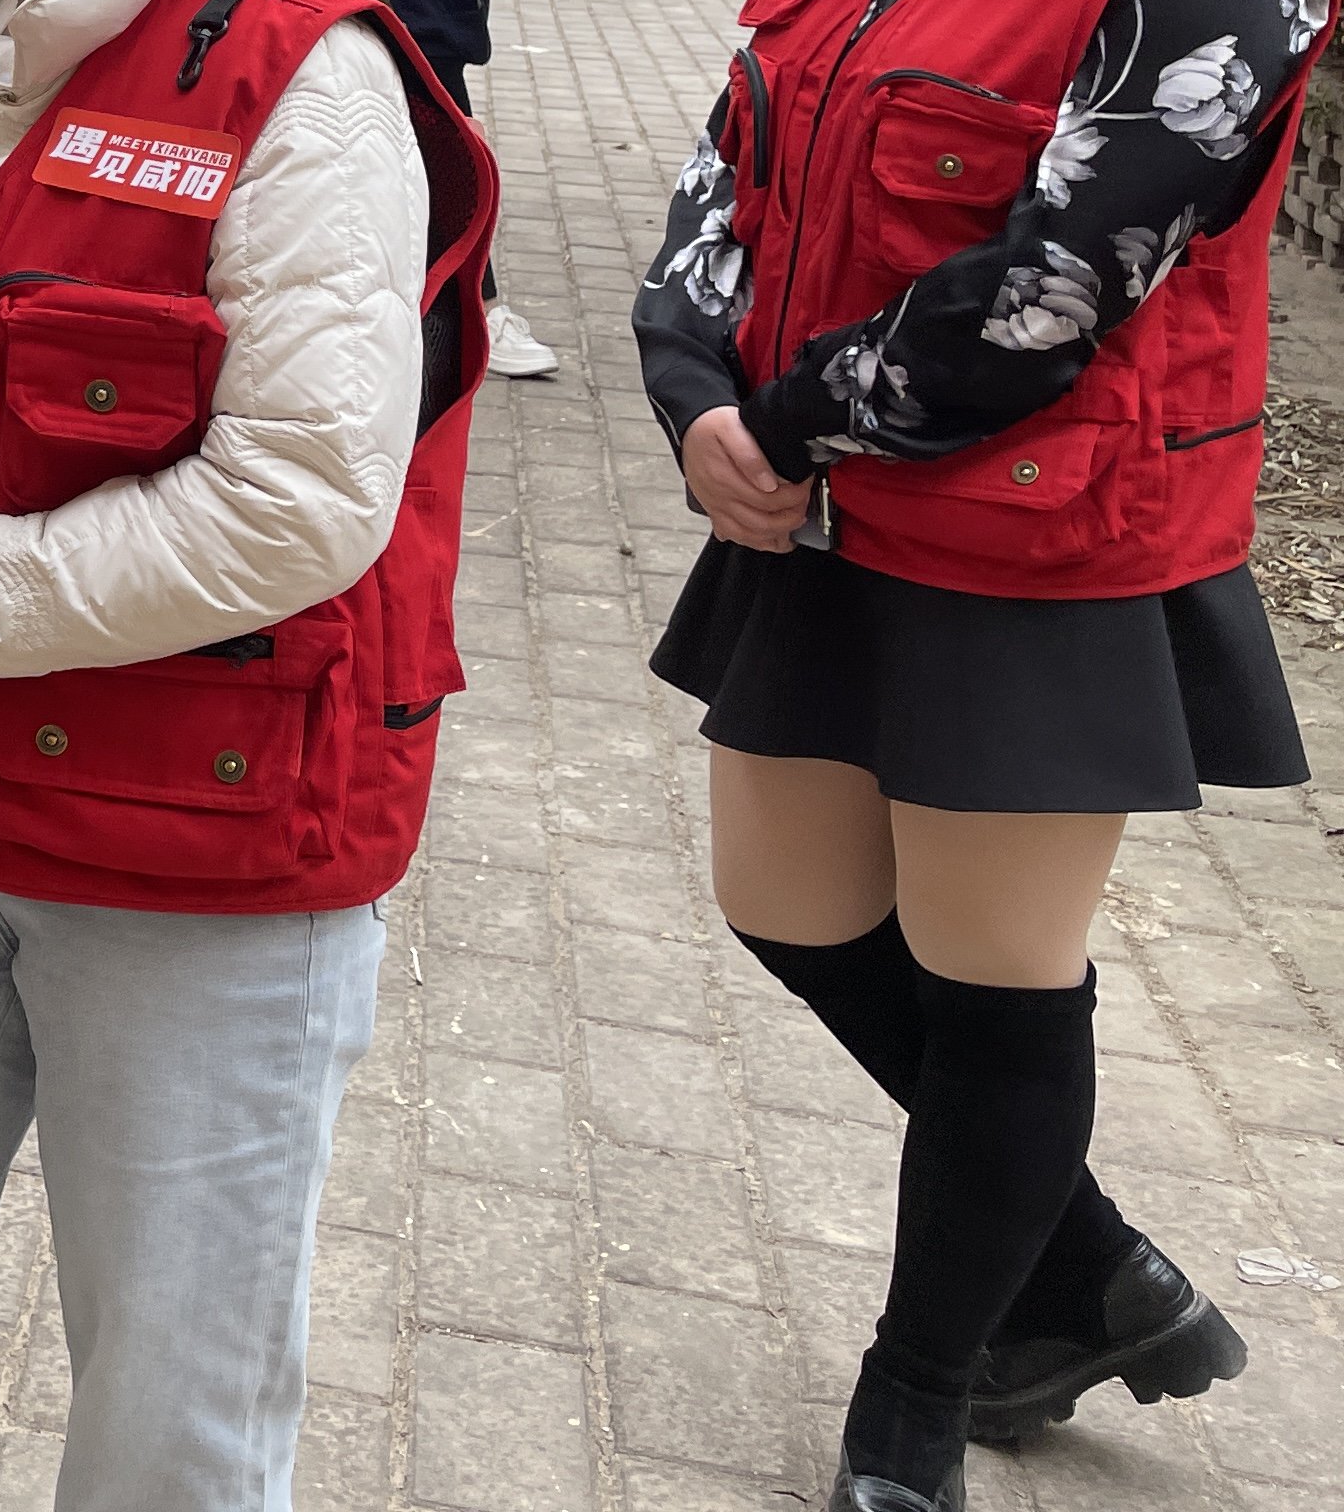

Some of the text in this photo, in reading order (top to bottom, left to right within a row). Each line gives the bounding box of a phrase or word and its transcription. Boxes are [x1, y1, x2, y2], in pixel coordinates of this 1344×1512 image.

[49, 124, 227, 201] 遇见咸阳
[109, 135, 231, 167] MEET XIANYANG
